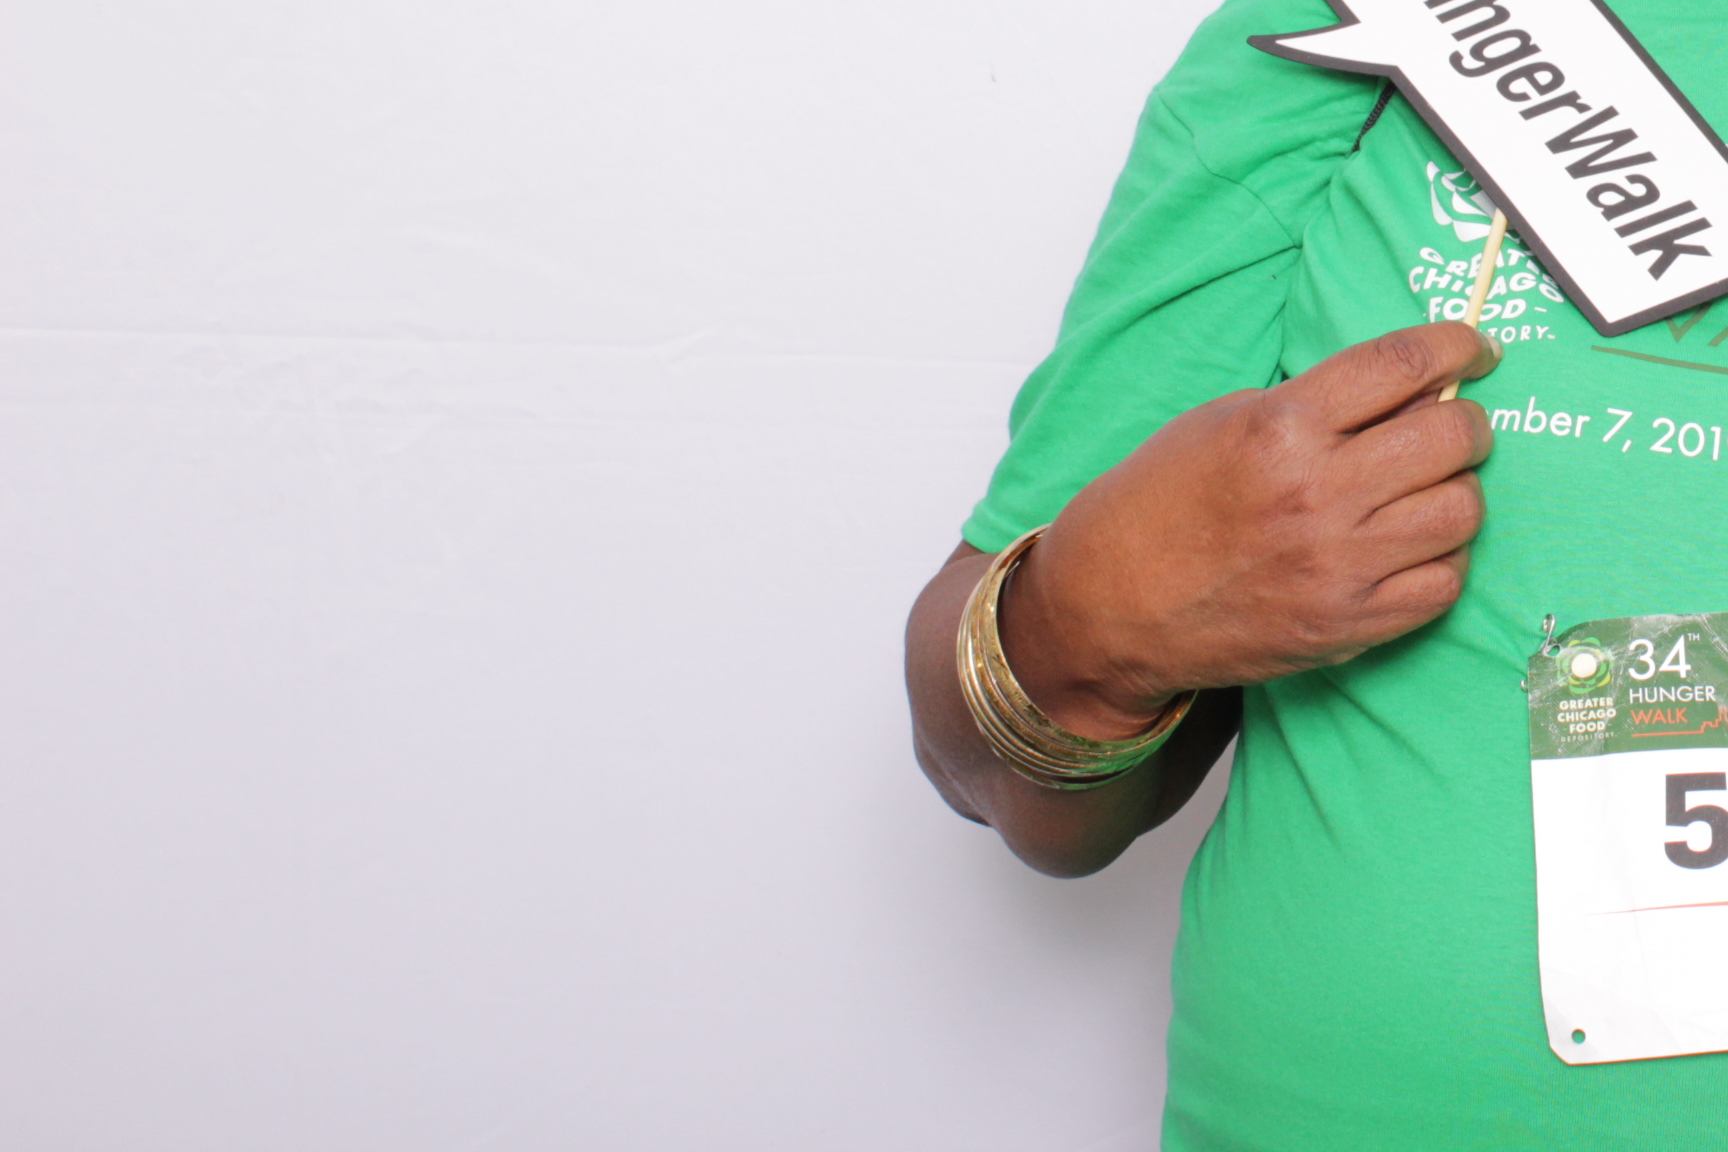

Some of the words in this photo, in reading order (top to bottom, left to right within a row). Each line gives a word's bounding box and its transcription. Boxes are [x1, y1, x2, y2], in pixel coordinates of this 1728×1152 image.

[1428, 297, 1527, 324] FOOD
[1602, 407, 1633, 453] 7,
[1559, 696, 1614, 711] GREATER
[1628, 685, 1716, 704] HUNGER
[1556, 708, 1617, 723] CHICAGO
[1630, 707, 1689, 725] WALK
[1569, 720, 1606, 734] FOOD
